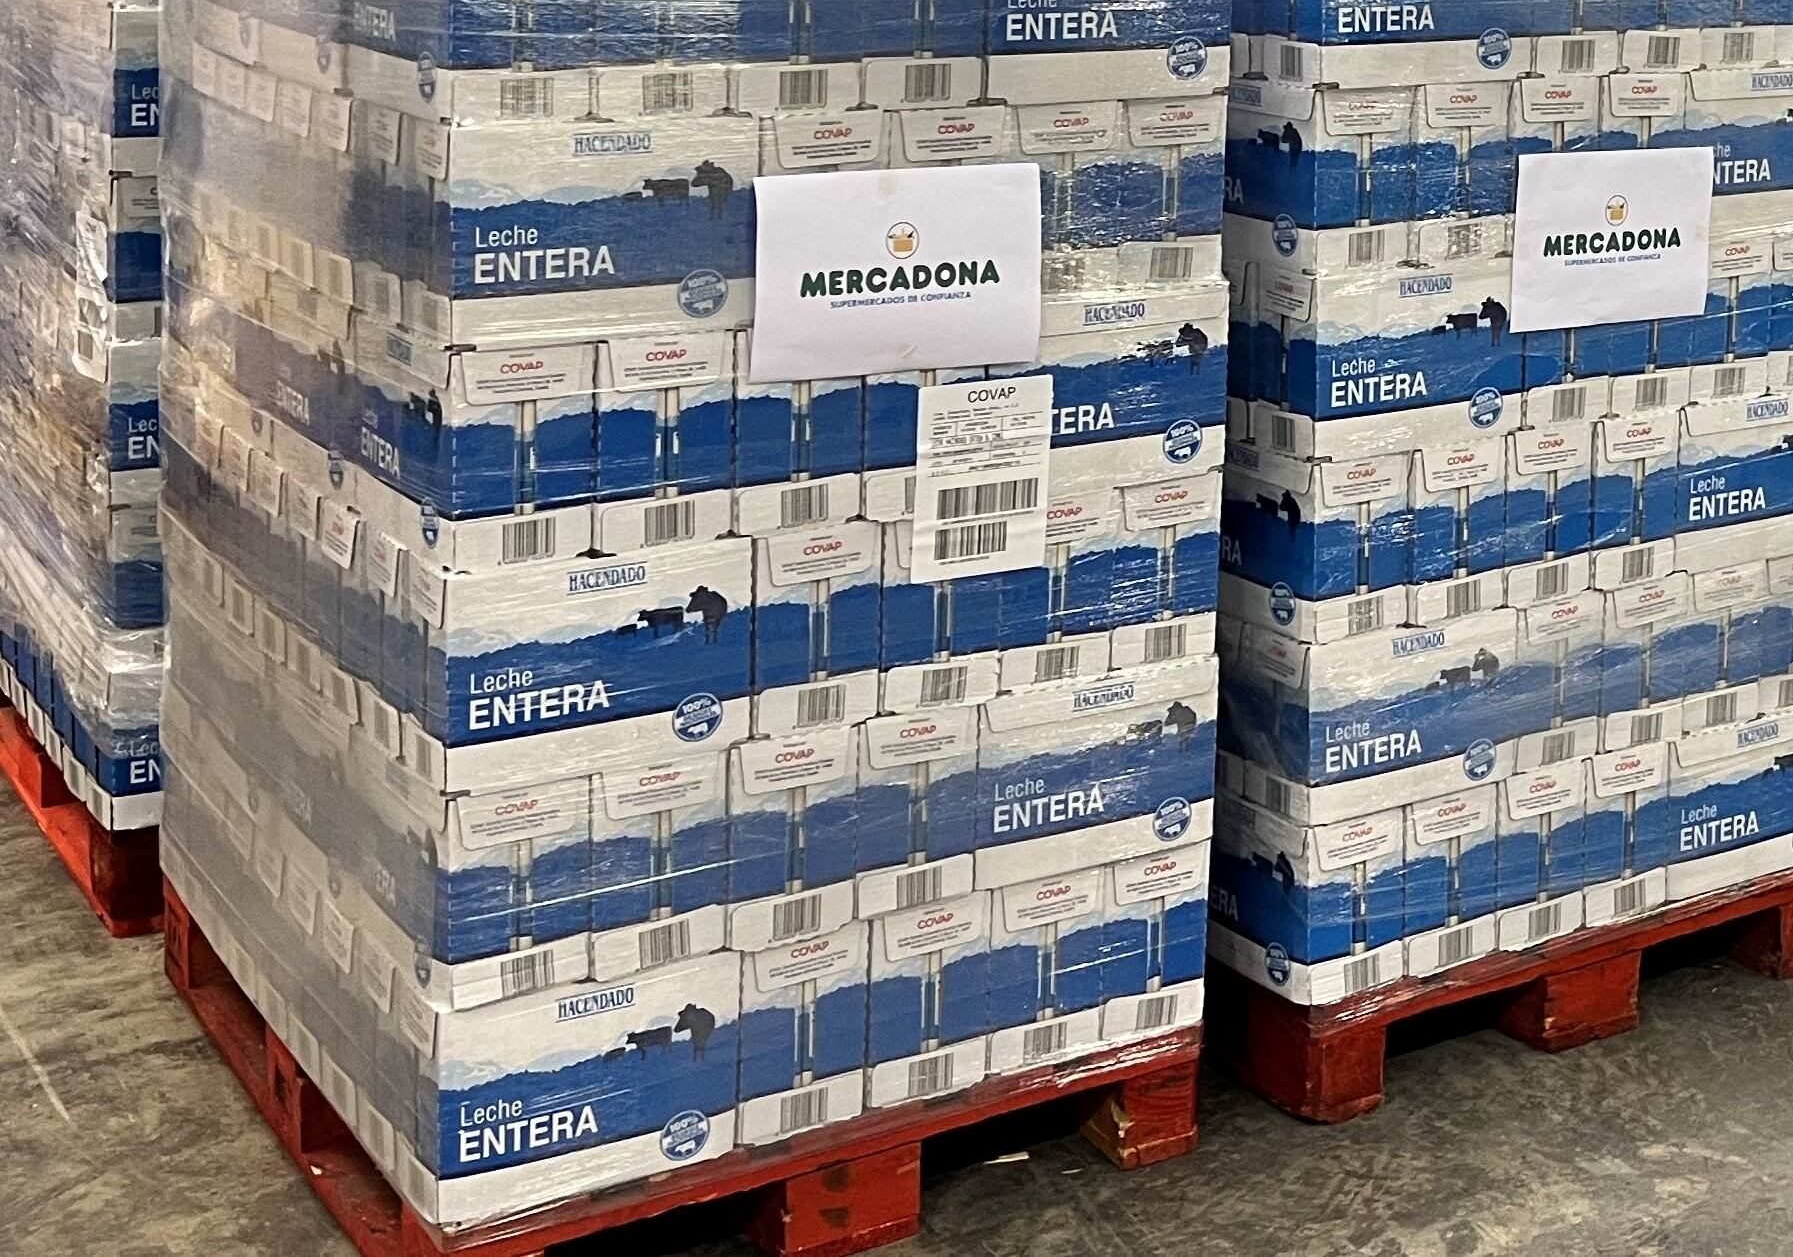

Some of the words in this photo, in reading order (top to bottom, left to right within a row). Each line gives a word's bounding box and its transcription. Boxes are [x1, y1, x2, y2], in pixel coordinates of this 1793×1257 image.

[1006, 11, 1118, 41] ENTERA
[1338, 5, 1435, 33] ENTERA
[1545, 90, 1571, 100] COVAP
[1632, 85, 1657, 95] COVAP
[1713, 159, 1771, 185] NTERA
[475, 225, 537, 248] Leche
[1544, 228, 1681, 257] MERCADONA
[1725, 245, 1750, 256] COVAP
[474, 246, 615, 284] ENTERA
[800, 260, 1000, 299] MERCADONA
[1401, 276, 1452, 295] HACENDADO
[646, 349, 686, 362] COVAP
[500, 361, 543, 374] COVAP
[1332, 359, 1376, 377] Leche
[967, 387, 1016, 403] COVAP
[1331, 371, 1427, 408] ENTERA
[1051, 403, 1114, 435] TERA
[1627, 427, 1652, 438] COVAP
[1538, 438, 1564, 449] COVAP
[1447, 453, 1474, 465] COVAP
[1347, 468, 1376, 480] COVAP
[1690, 476, 1725, 494] Leche
[1155, 491, 1187, 504] COVAP
[1689, 486, 1765, 521] ENTERA
[1047, 507, 1082, 520] COVAP
[804, 542, 842, 557] COVAP
[569, 566, 646, 592] HACENDADO
[1552, 606, 1578, 619] COVAP
[470, 669, 533, 694] Leche
[469, 680, 610, 731] ENTERA
[900, 725, 936, 739] COVAP
[1326, 720, 1370, 743] Leche
[775, 748, 814, 764] COVAP
[1326, 730, 1422, 773] ENTERA
[1615, 759, 1640, 772] COVAP
[994, 777, 1044, 800] Leche
[1530, 781, 1557, 793] COVAP
[993, 784, 1104, 833] ENTERA
[1438, 803, 1466, 817] COVAP
[1681, 804, 1717, 824] Leche
[1343, 827, 1372, 842] COVAP
[1680, 812, 1759, 852] ENTERA
[1144, 861, 1177, 877] COVAP
[1036, 885, 1071, 901] COVAP
[917, 913, 954, 930] COVAP
[791, 941, 829, 959] COVAP
[558, 987, 634, 1017] HACENDADO
[461, 1100, 522, 1126] Leche
[459, 1105, 598, 1163] ENTERA
